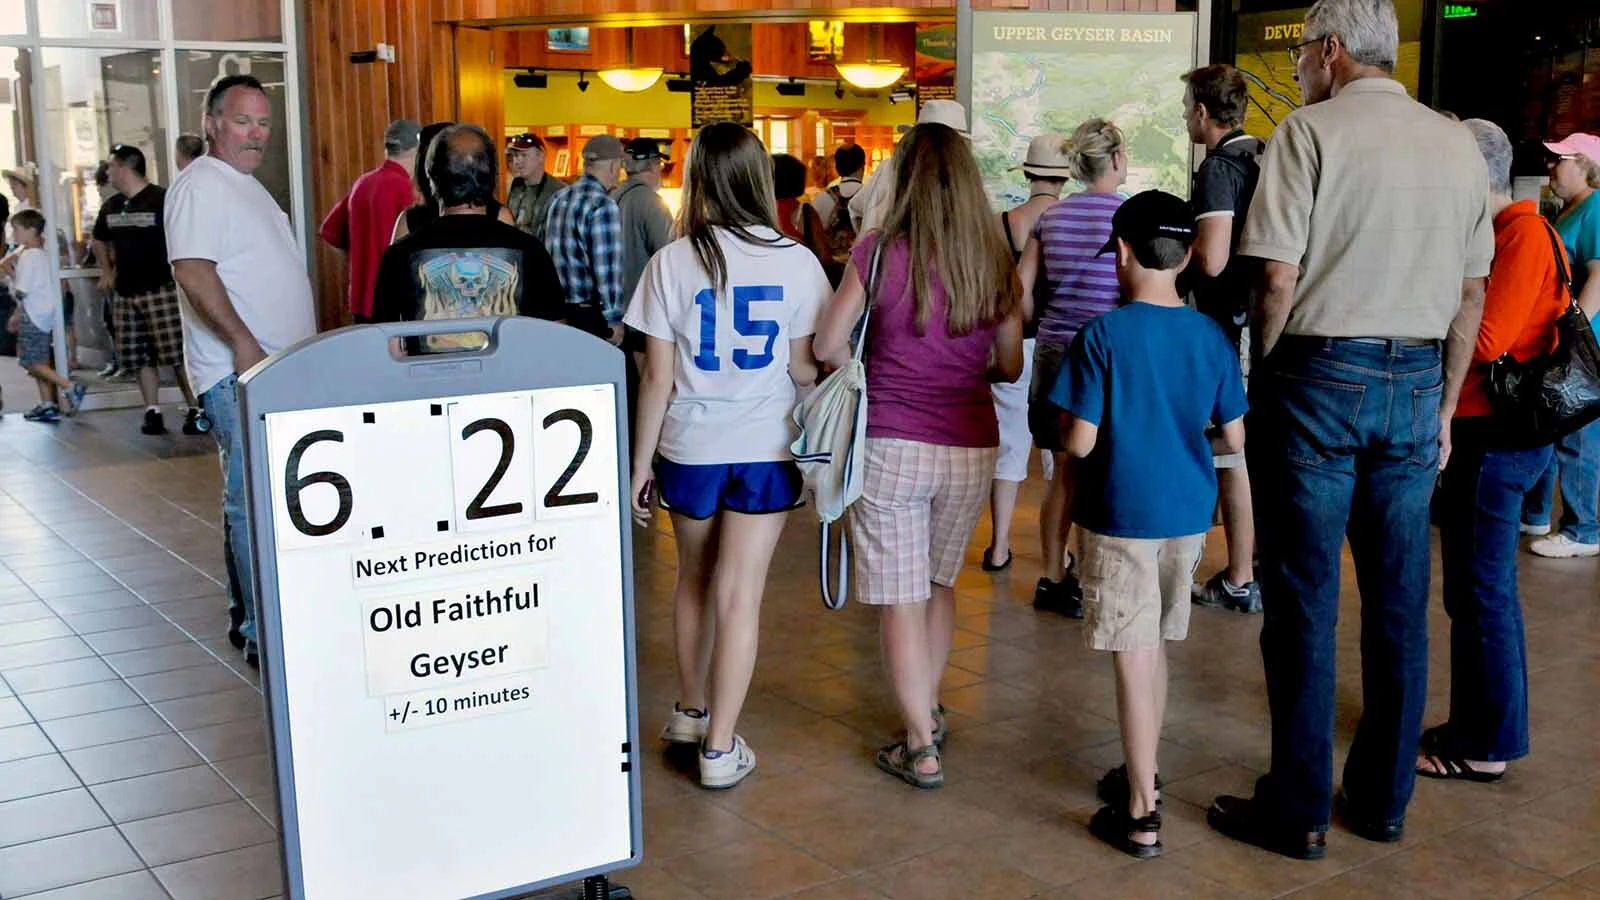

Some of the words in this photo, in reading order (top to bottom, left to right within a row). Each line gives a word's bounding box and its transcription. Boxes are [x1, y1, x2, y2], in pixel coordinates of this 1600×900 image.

[992, 26, 1049, 41] UPPER
[1050, 27, 1115, 42] GEYSER
[1119, 28, 1173, 43] BASIN
[694, 285, 784, 372] 15
[356, 555, 408, 578] Next
[415, 539, 522, 569] Prediction
[527, 534, 558, 553] for
[370, 601, 422, 633] Old
[432, 583, 539, 624] Faithful
[410, 644, 509, 678] Geyser
[389, 701, 419, 724] +/-
[425, 697, 448, 716] 10
[453, 686, 530, 712] minutes
